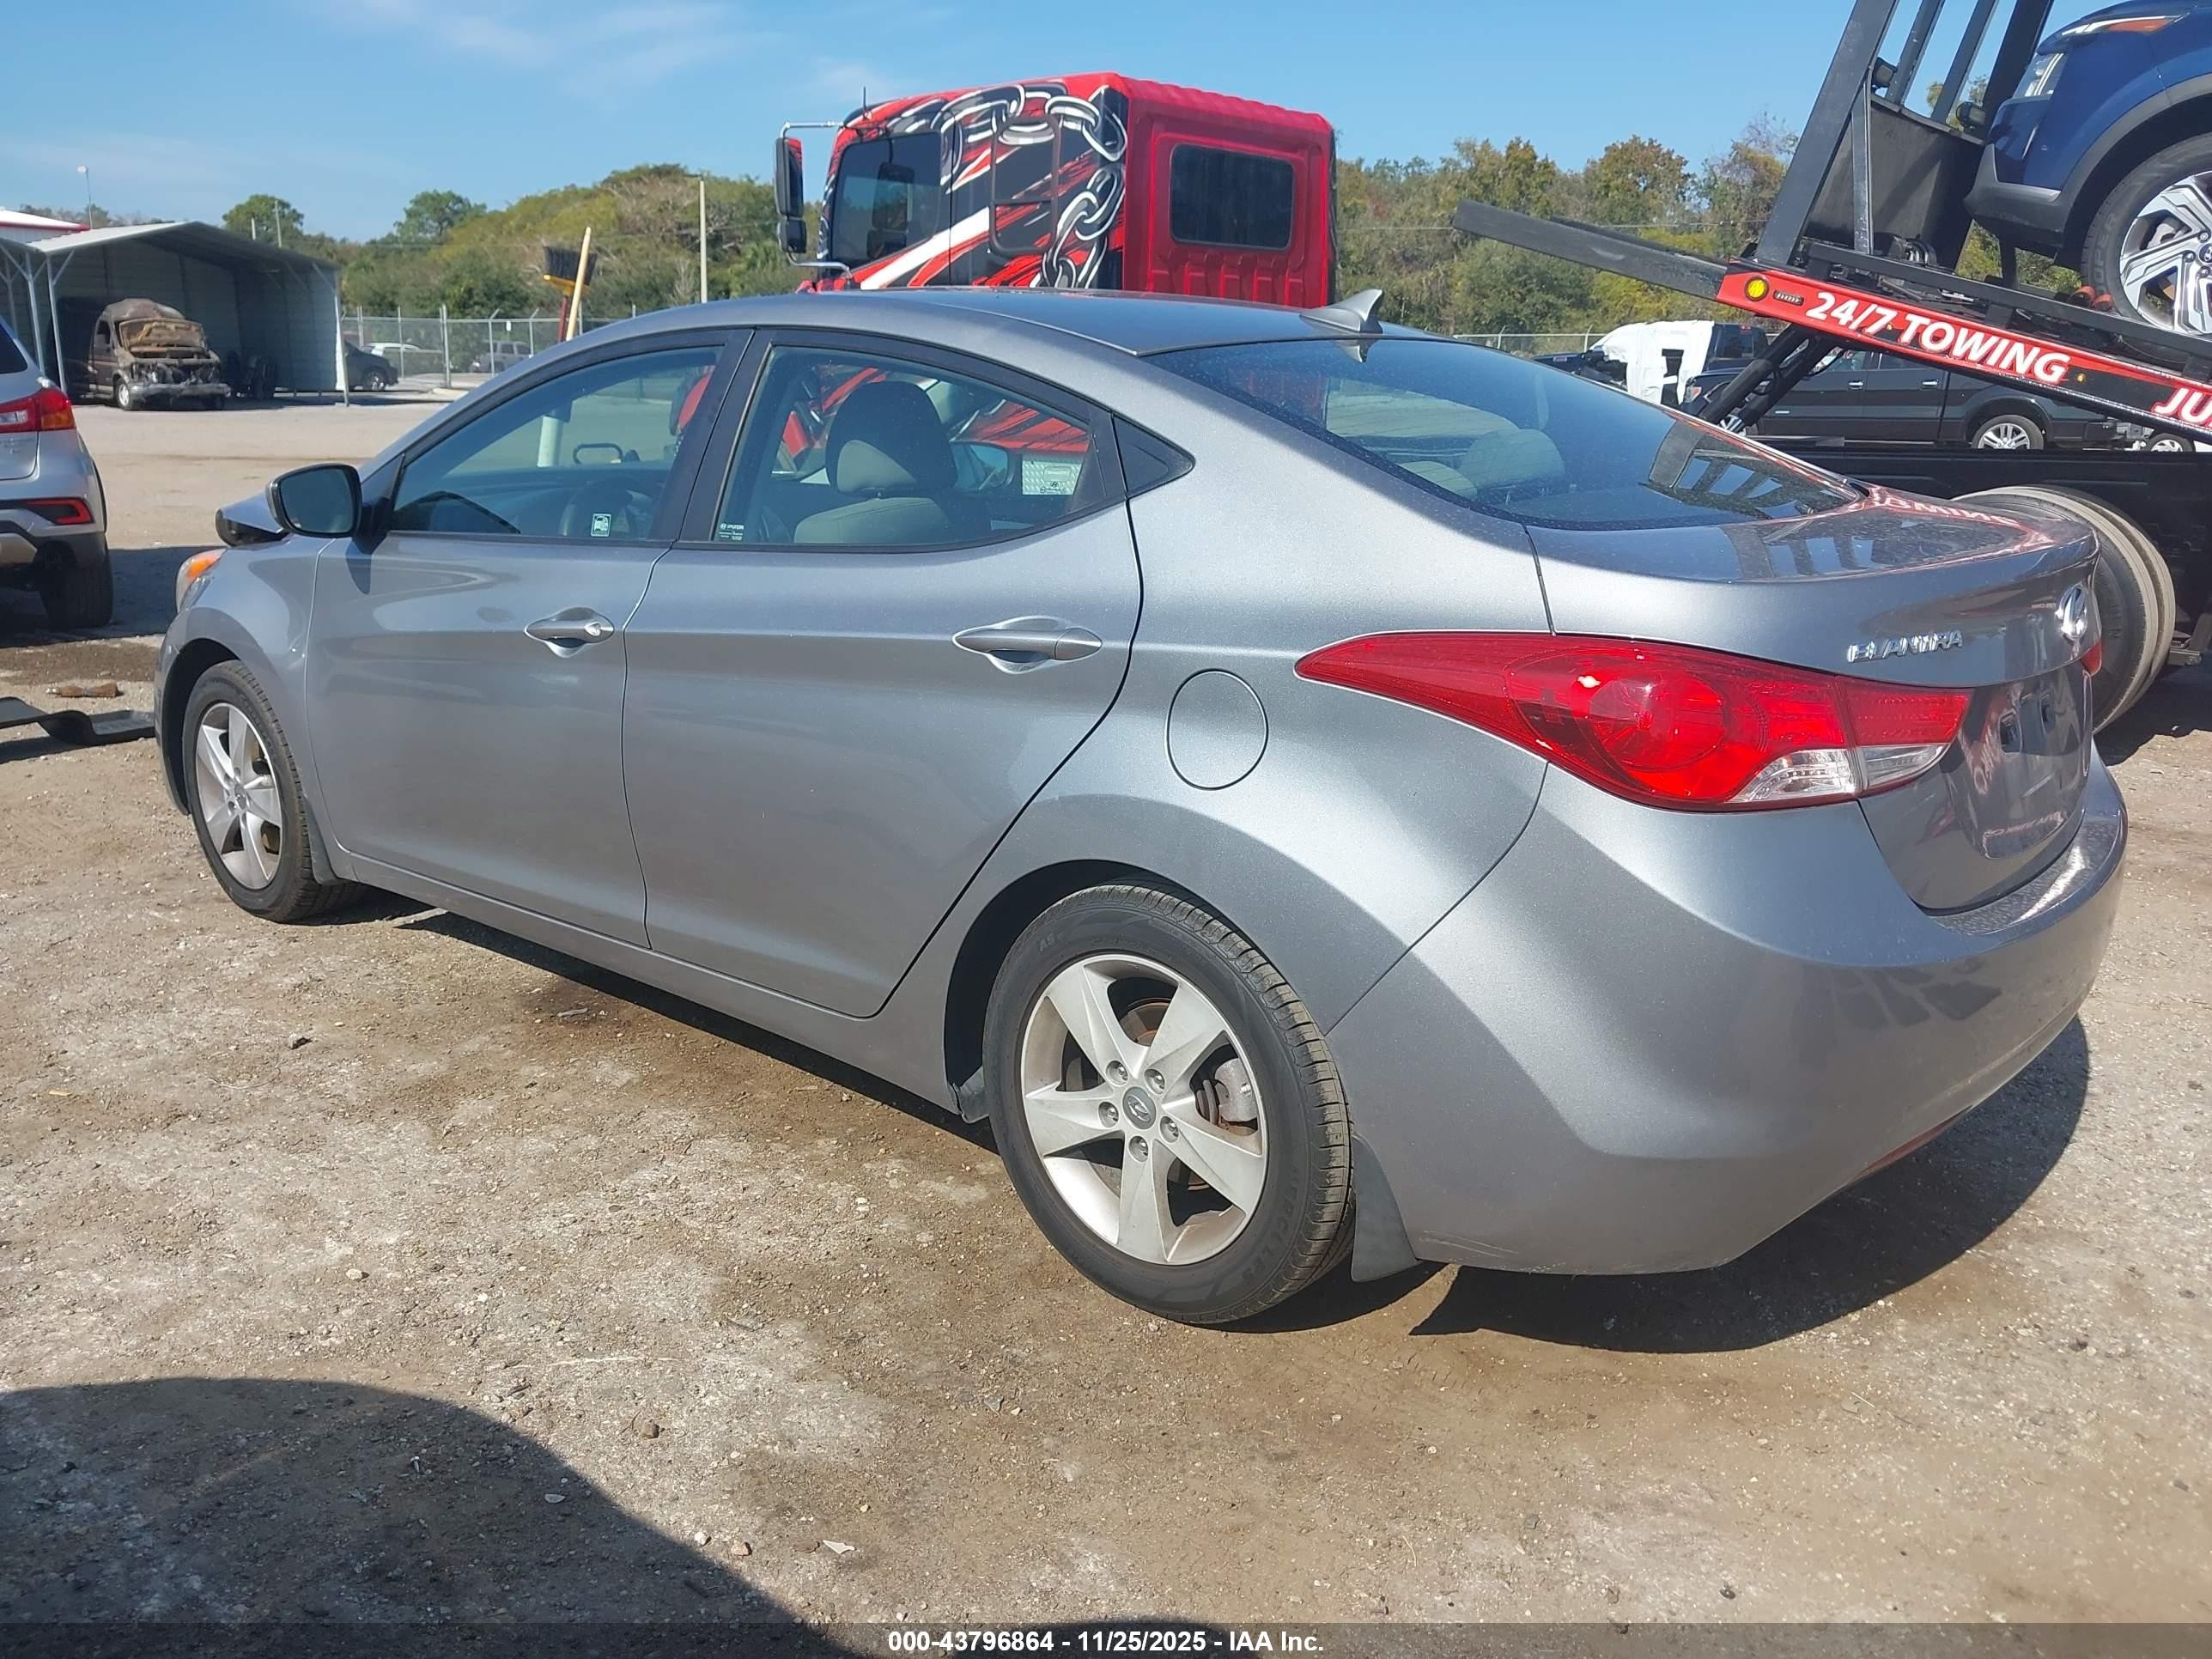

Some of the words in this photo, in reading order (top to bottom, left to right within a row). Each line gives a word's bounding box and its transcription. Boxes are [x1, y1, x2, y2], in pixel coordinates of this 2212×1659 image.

[1805, 290, 1898, 336] 24/7
[1899, 313, 2070, 384] TOWING
[2153, 386, 2212, 423] JU
[1847, 630, 1963, 663] ELANTRA
